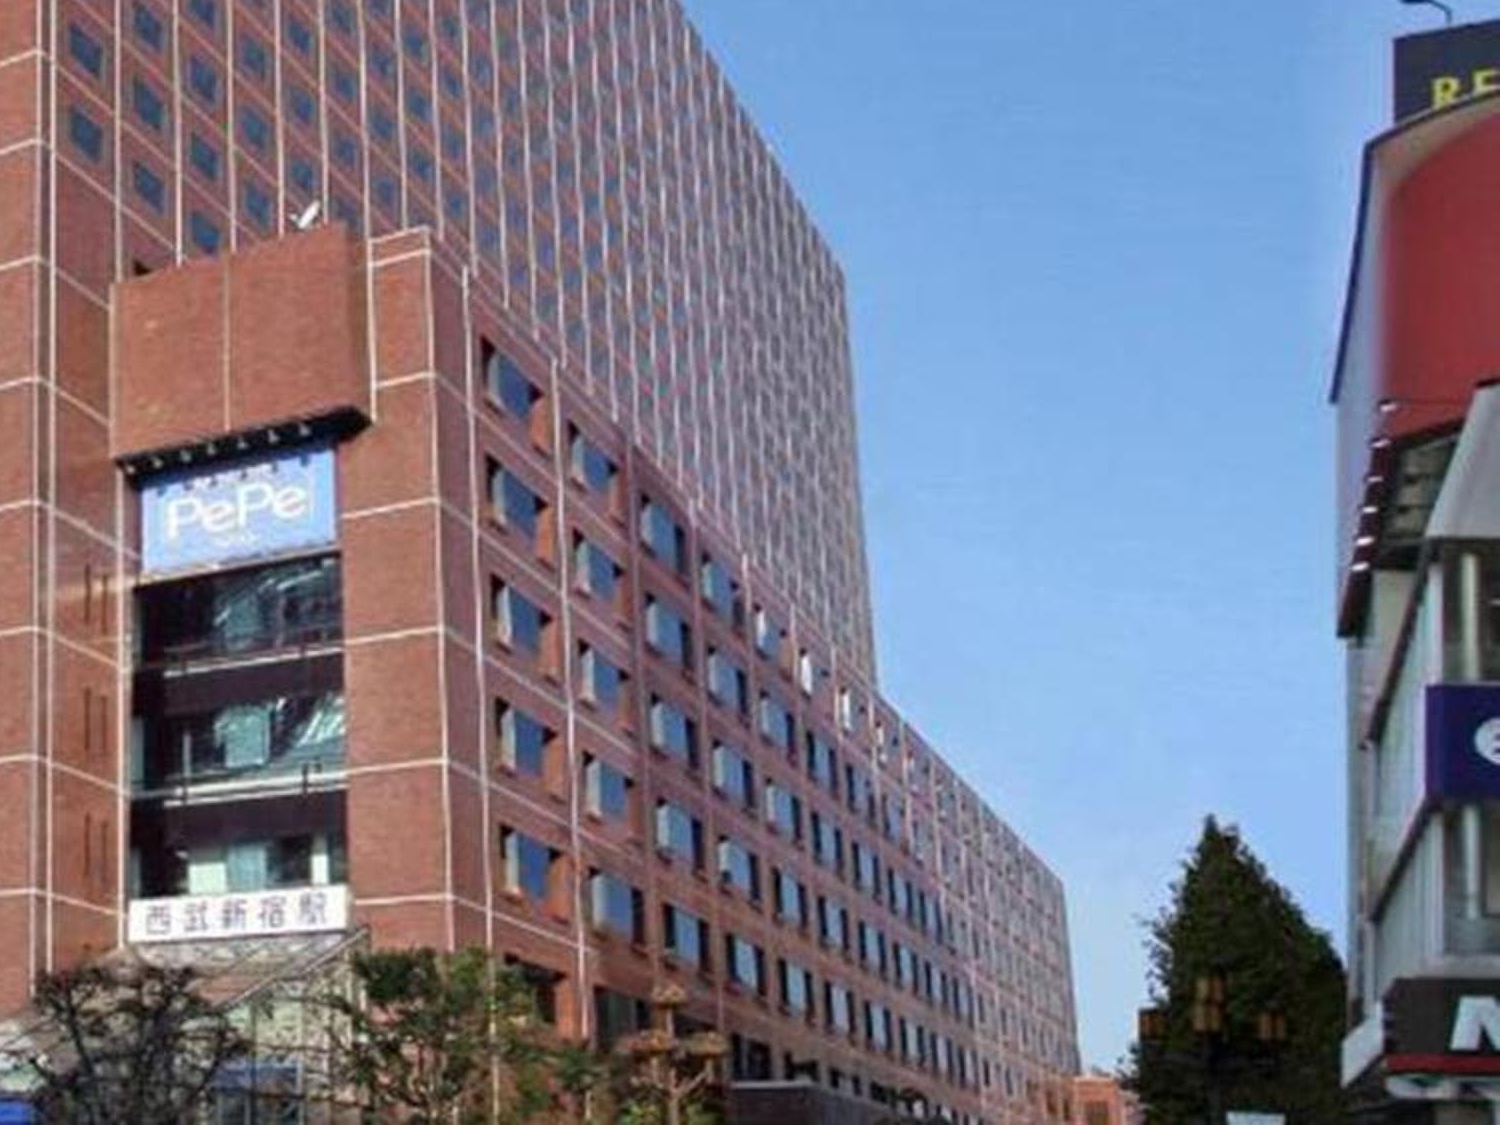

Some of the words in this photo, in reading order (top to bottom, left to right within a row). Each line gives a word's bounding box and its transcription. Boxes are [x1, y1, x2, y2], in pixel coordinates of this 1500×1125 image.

[166, 481, 307, 539] PePe
[145, 891, 327, 935] 西武新宿駅
